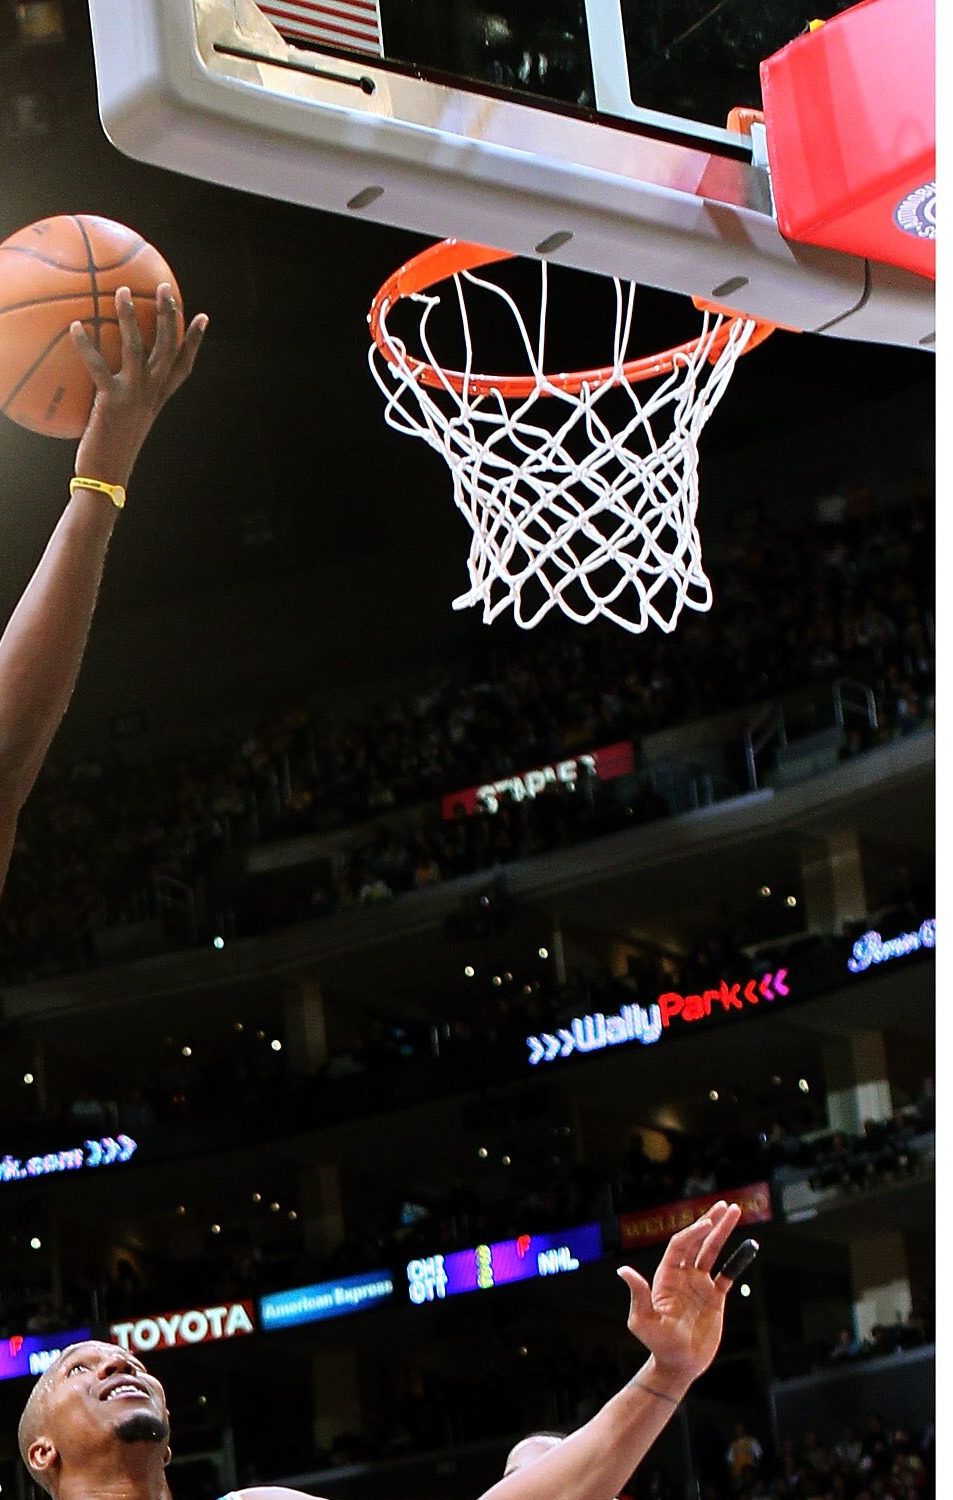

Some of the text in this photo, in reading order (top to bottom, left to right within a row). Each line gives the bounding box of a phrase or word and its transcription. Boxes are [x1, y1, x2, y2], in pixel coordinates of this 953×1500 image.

[571, 980, 743, 1053] WallyPark
[538, 1246, 580, 1276] NHL
[262, 1280, 394, 1321] American Express
[110, 1303, 253, 1352] TOYOTA
